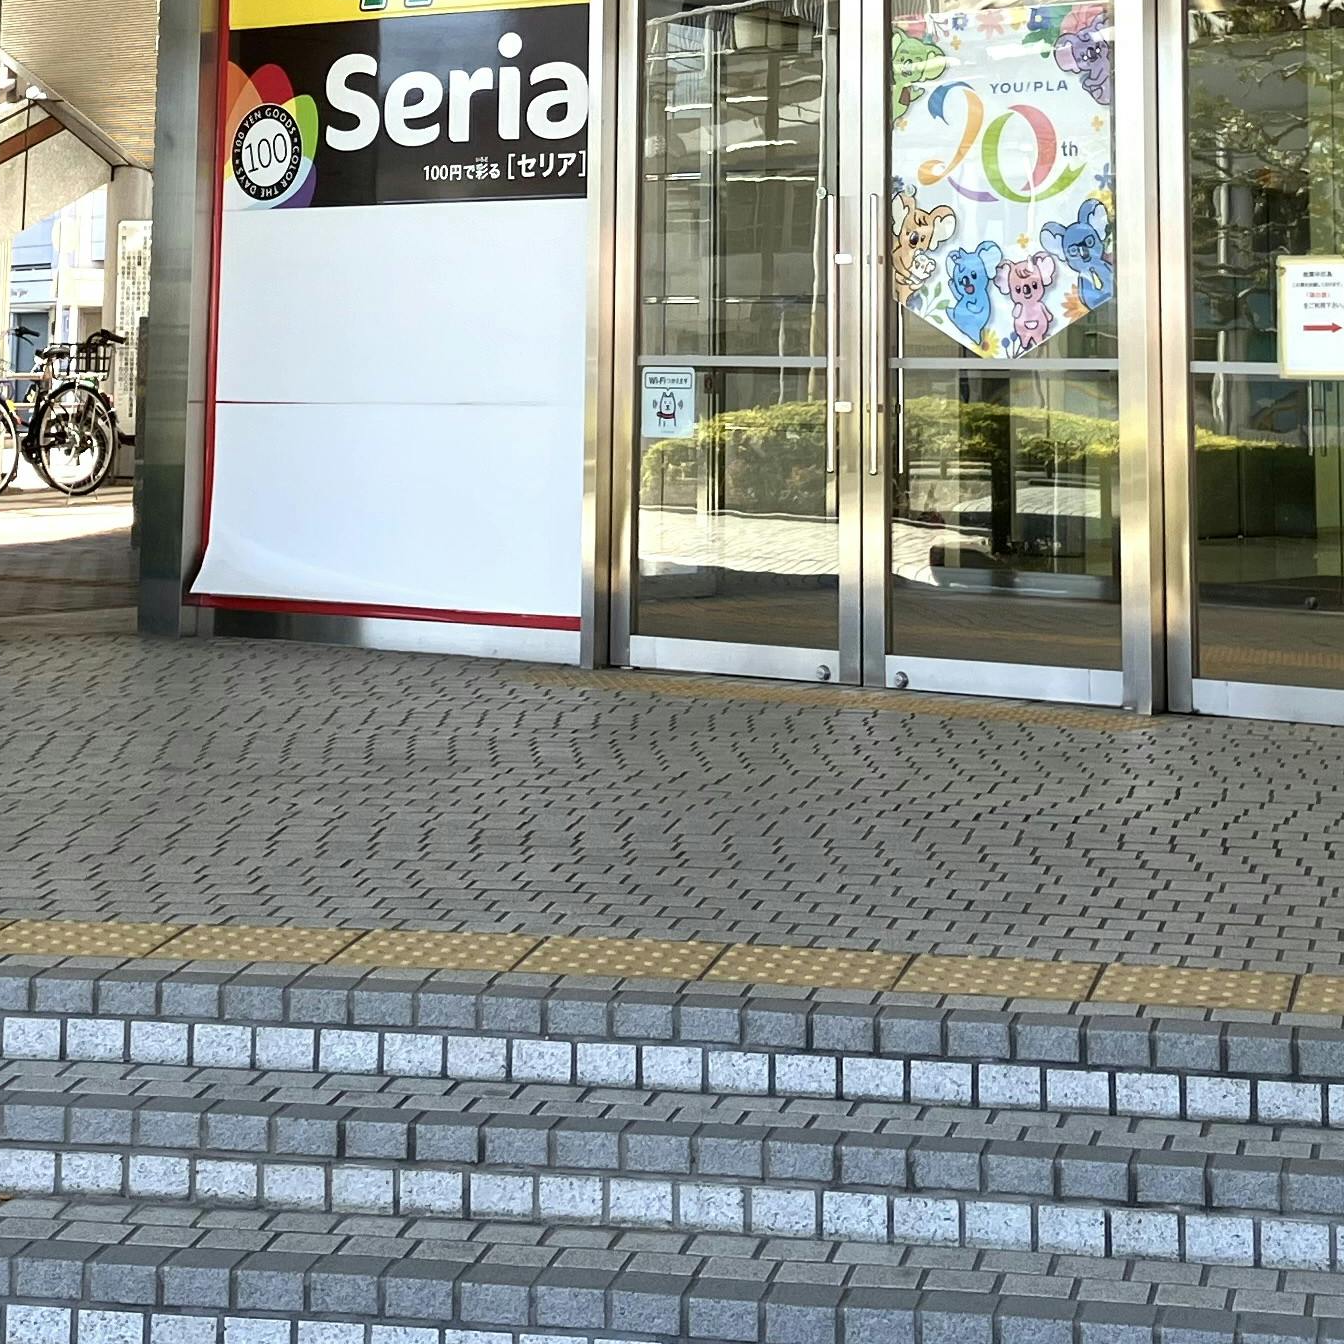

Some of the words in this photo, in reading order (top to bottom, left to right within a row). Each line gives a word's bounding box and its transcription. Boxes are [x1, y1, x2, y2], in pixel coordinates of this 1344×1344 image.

[325, 32, 590, 152] Seria
[244, 110, 262, 129] YEN
[265, 107, 296, 135] GOODS
[234, 131, 245, 153] 100
[244, 133, 288, 173] 100
[1061, 141, 1078, 157] th
[281, 146, 300, 188] COLOR
[423, 163, 501, 181] 100円で彩る
[236, 166, 257, 195] DAYS
[260, 186, 279, 198] THE
